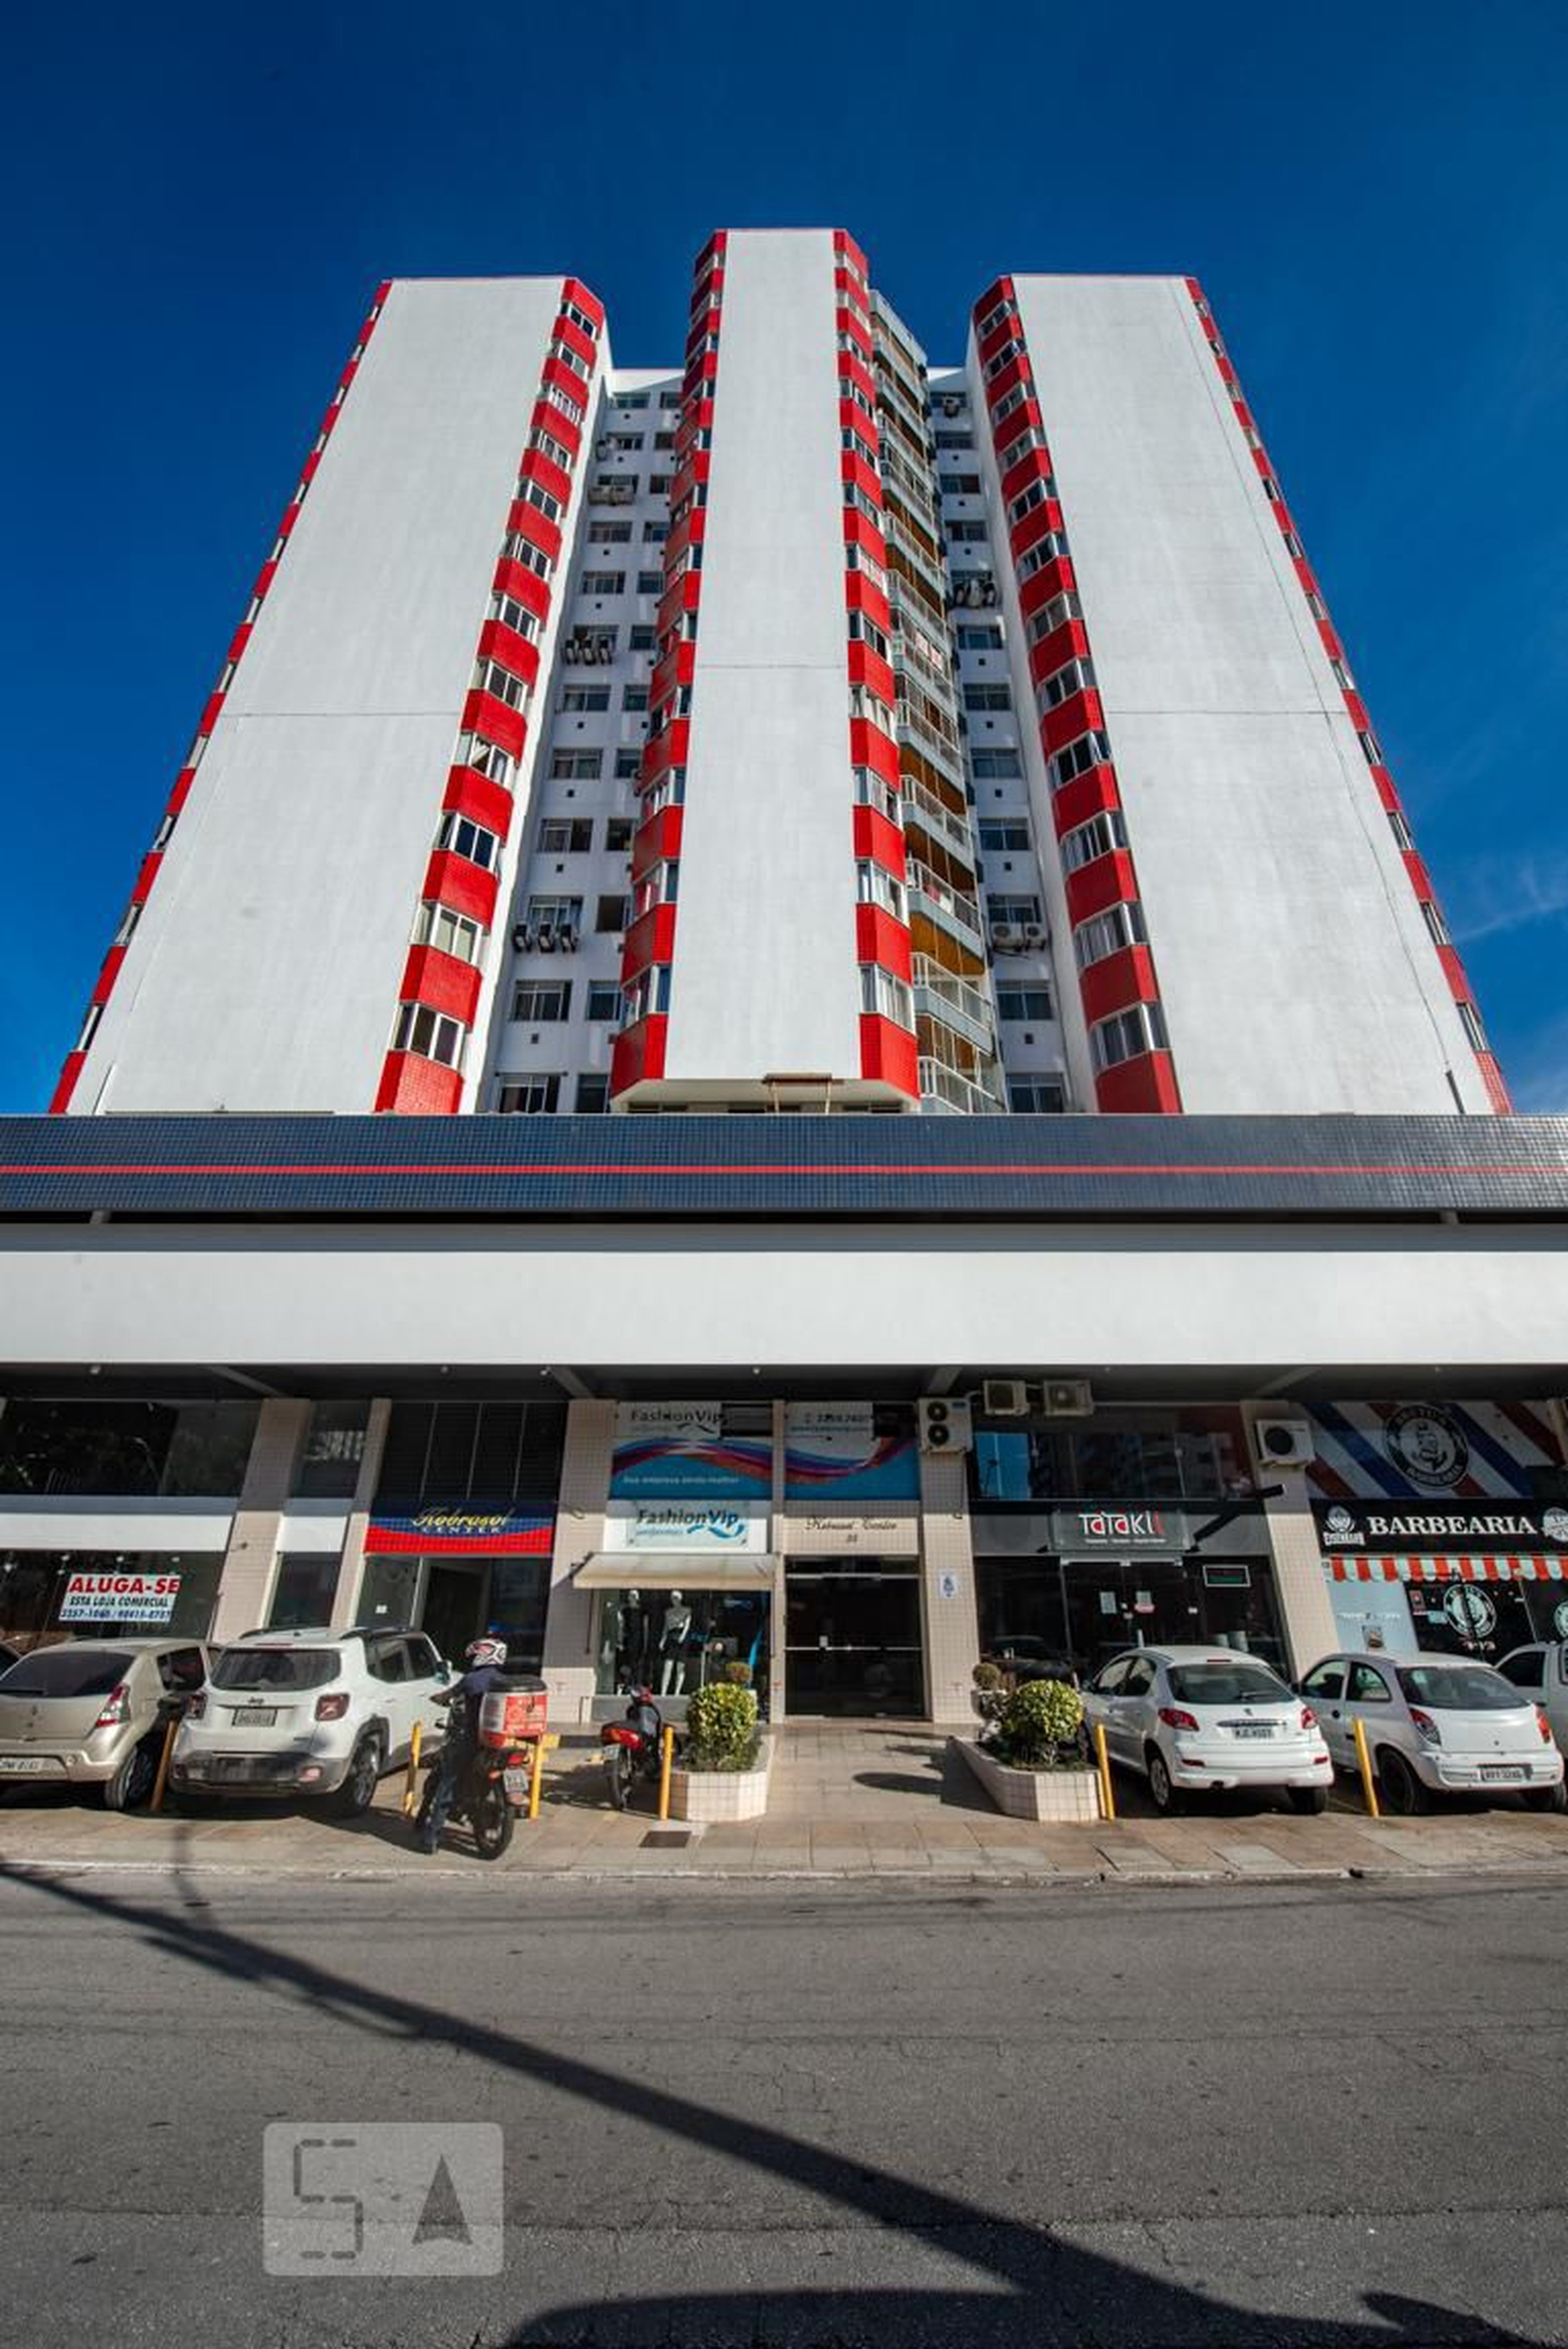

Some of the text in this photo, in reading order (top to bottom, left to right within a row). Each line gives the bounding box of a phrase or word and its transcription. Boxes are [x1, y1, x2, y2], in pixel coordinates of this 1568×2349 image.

[636, 1510, 738, 1528] FashionVip
[1367, 1516, 1538, 1534] BARBEARIA
[69, 1577, 181, 1594] ALUGA-SE
[69, 1596, 91, 1606] ESTA
[118, 1597, 168, 1607] COMERCIAL
